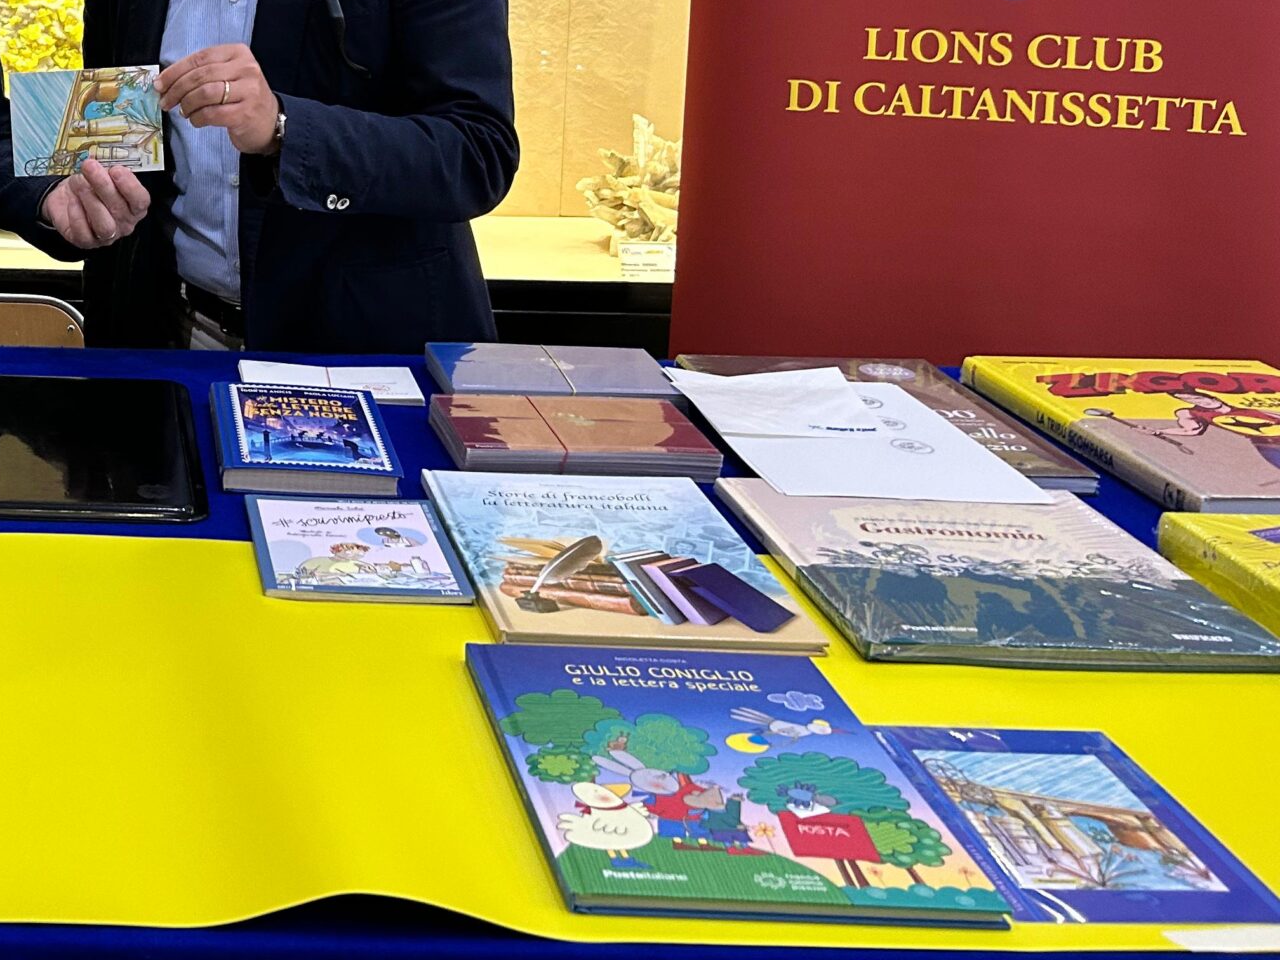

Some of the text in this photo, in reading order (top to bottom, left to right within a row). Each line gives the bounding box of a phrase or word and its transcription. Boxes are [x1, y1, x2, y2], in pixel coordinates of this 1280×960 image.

[863, 26, 1164, 74] LIONS CLUB
[785, 79, 1248, 137] DI CALTANISSETTA
[270, 396, 342, 406] MISTERO
[281, 403, 353, 414] LETTERE
[308, 411, 358, 421] NOME
[487, 490, 652, 503] Storie di francobolli
[504, 499, 594, 510] letteratura
[601, 502, 669, 511] italiana
[859, 521, 1047, 541] Gastronomia
[564, 663, 754, 682] GIULIO CONIGLIO
[572, 676, 762, 692] e la lettera speciale
[798, 824, 850, 838] POSTA
